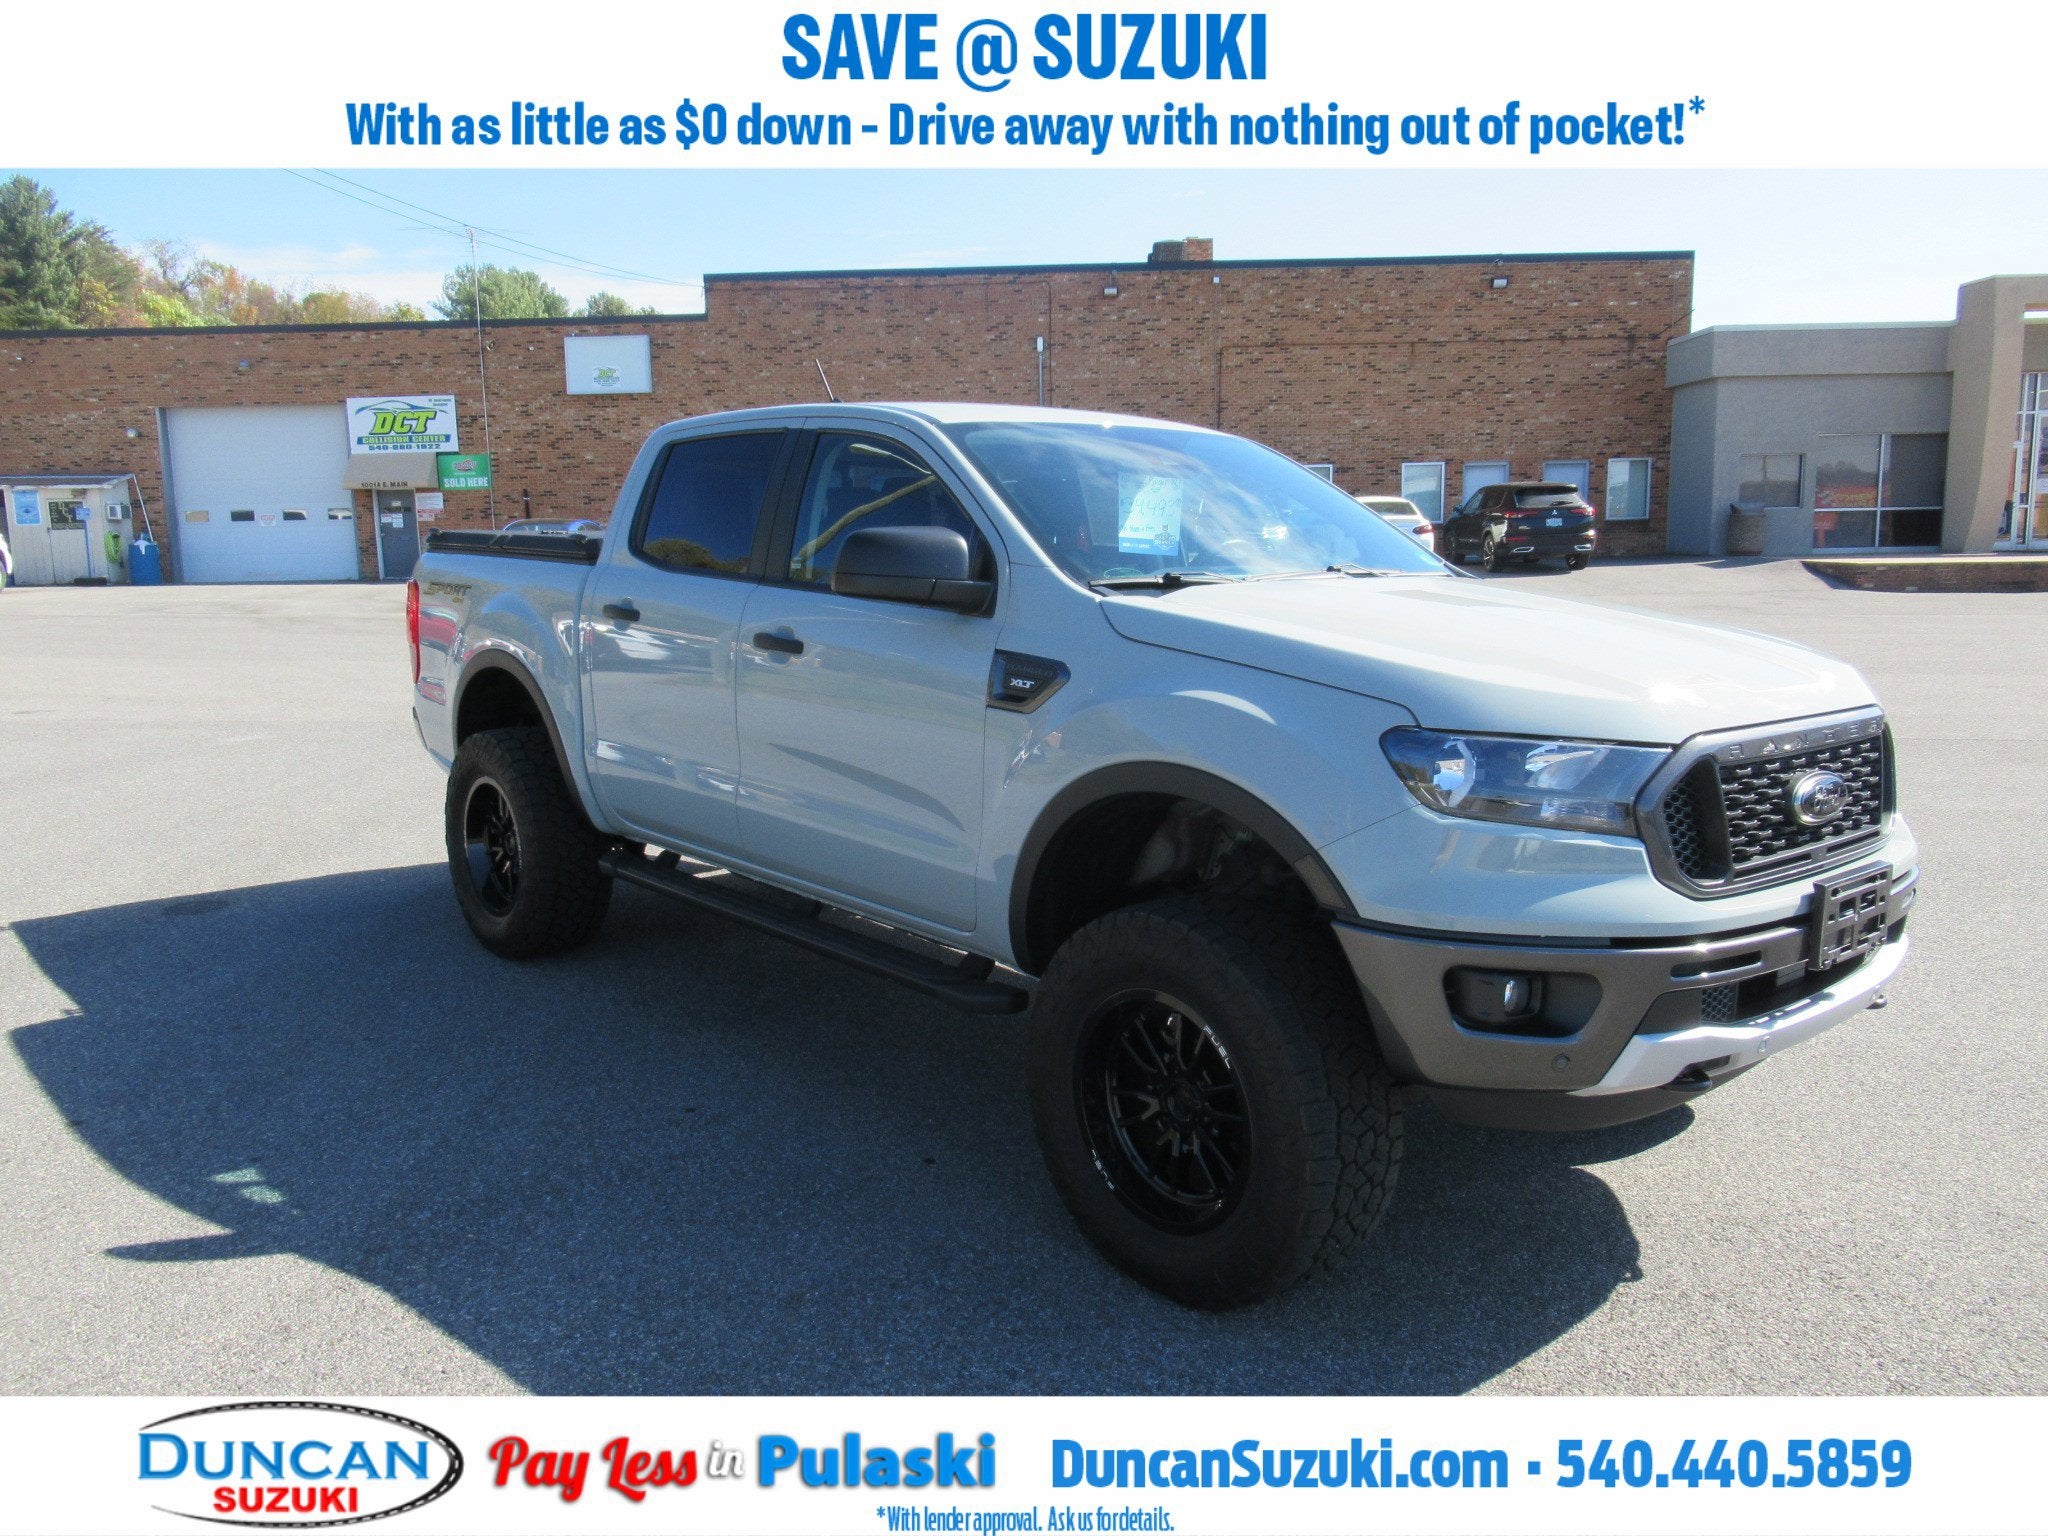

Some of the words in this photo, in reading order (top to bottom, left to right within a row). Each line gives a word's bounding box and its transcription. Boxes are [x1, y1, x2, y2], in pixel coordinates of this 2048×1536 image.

[370, 411, 437, 435] DCT
[443, 477, 466, 488] SOLD
[467, 477, 489, 487] HERE
[423, 582, 472, 596] SPORT
[1010, 678, 1035, 689] XLT
[1202, 1025, 1230, 1069] FUEL
